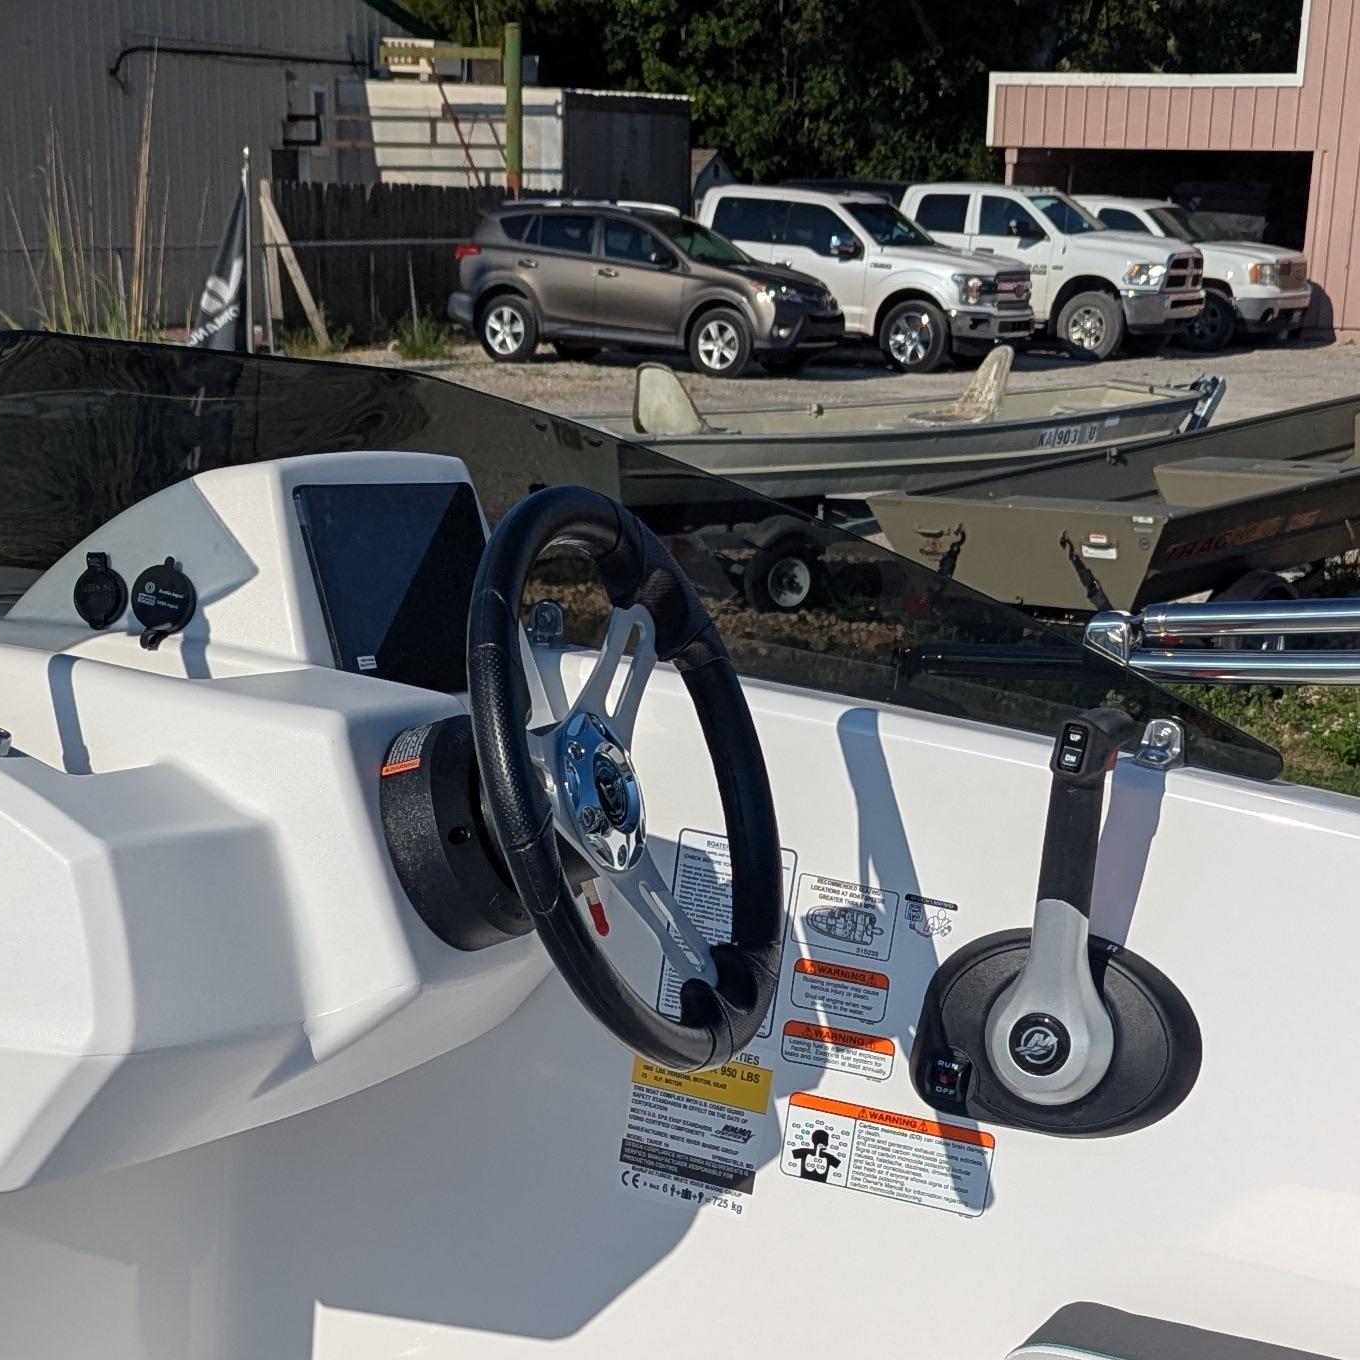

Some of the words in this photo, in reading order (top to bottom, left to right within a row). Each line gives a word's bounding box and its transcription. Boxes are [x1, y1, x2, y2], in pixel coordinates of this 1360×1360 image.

[1056, 429, 1078, 445] 903
[1070, 733, 1081, 742] UP
[817, 965, 866, 982] WARNING
[814, 1027, 865, 1048] WARNING
[937, 1060, 958, 1070] RUN
[720, 1066, 738, 1079] 950
[740, 1069, 761, 1084] LBS
[869, 1111, 918, 1129] WARNING
[621, 1170, 641, 1189] CE
[662, 1184, 668, 1193] 6
[712, 1196, 729, 1210] 725
[731, 1200, 743, 1213] kg
